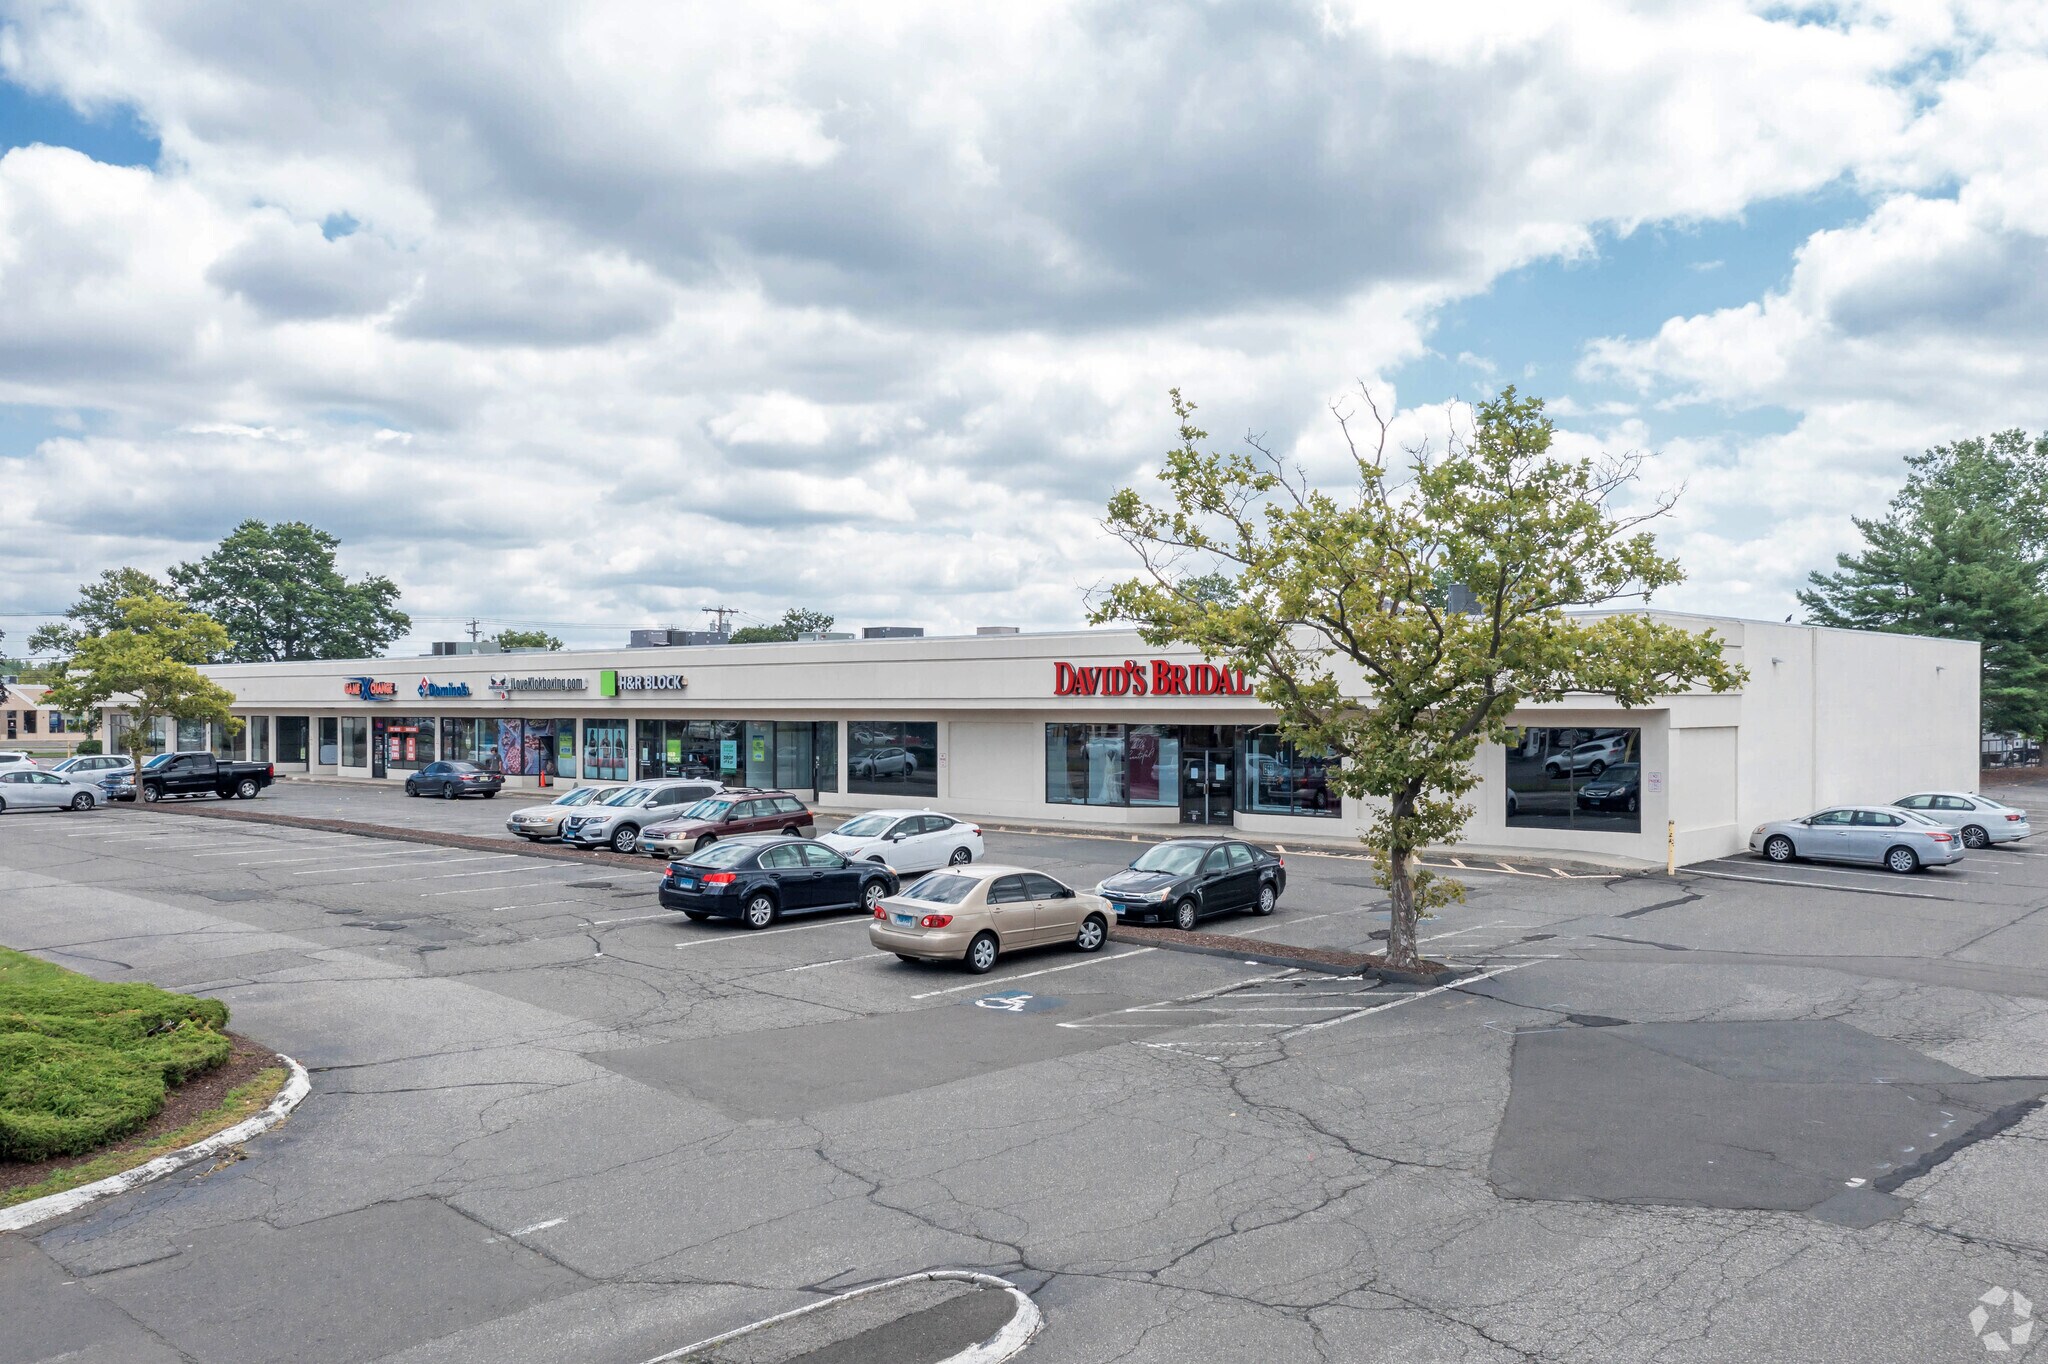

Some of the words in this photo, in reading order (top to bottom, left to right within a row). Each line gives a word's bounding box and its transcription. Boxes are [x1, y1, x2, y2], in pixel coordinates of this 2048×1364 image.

[619, 675, 642, 690] H&R
[644, 674, 682, 690] BLOCK
[1054, 660, 1147, 695] DAVID'S
[1150, 659, 1253, 695] BRIDAL
[428, 681, 470, 697] Domino's
